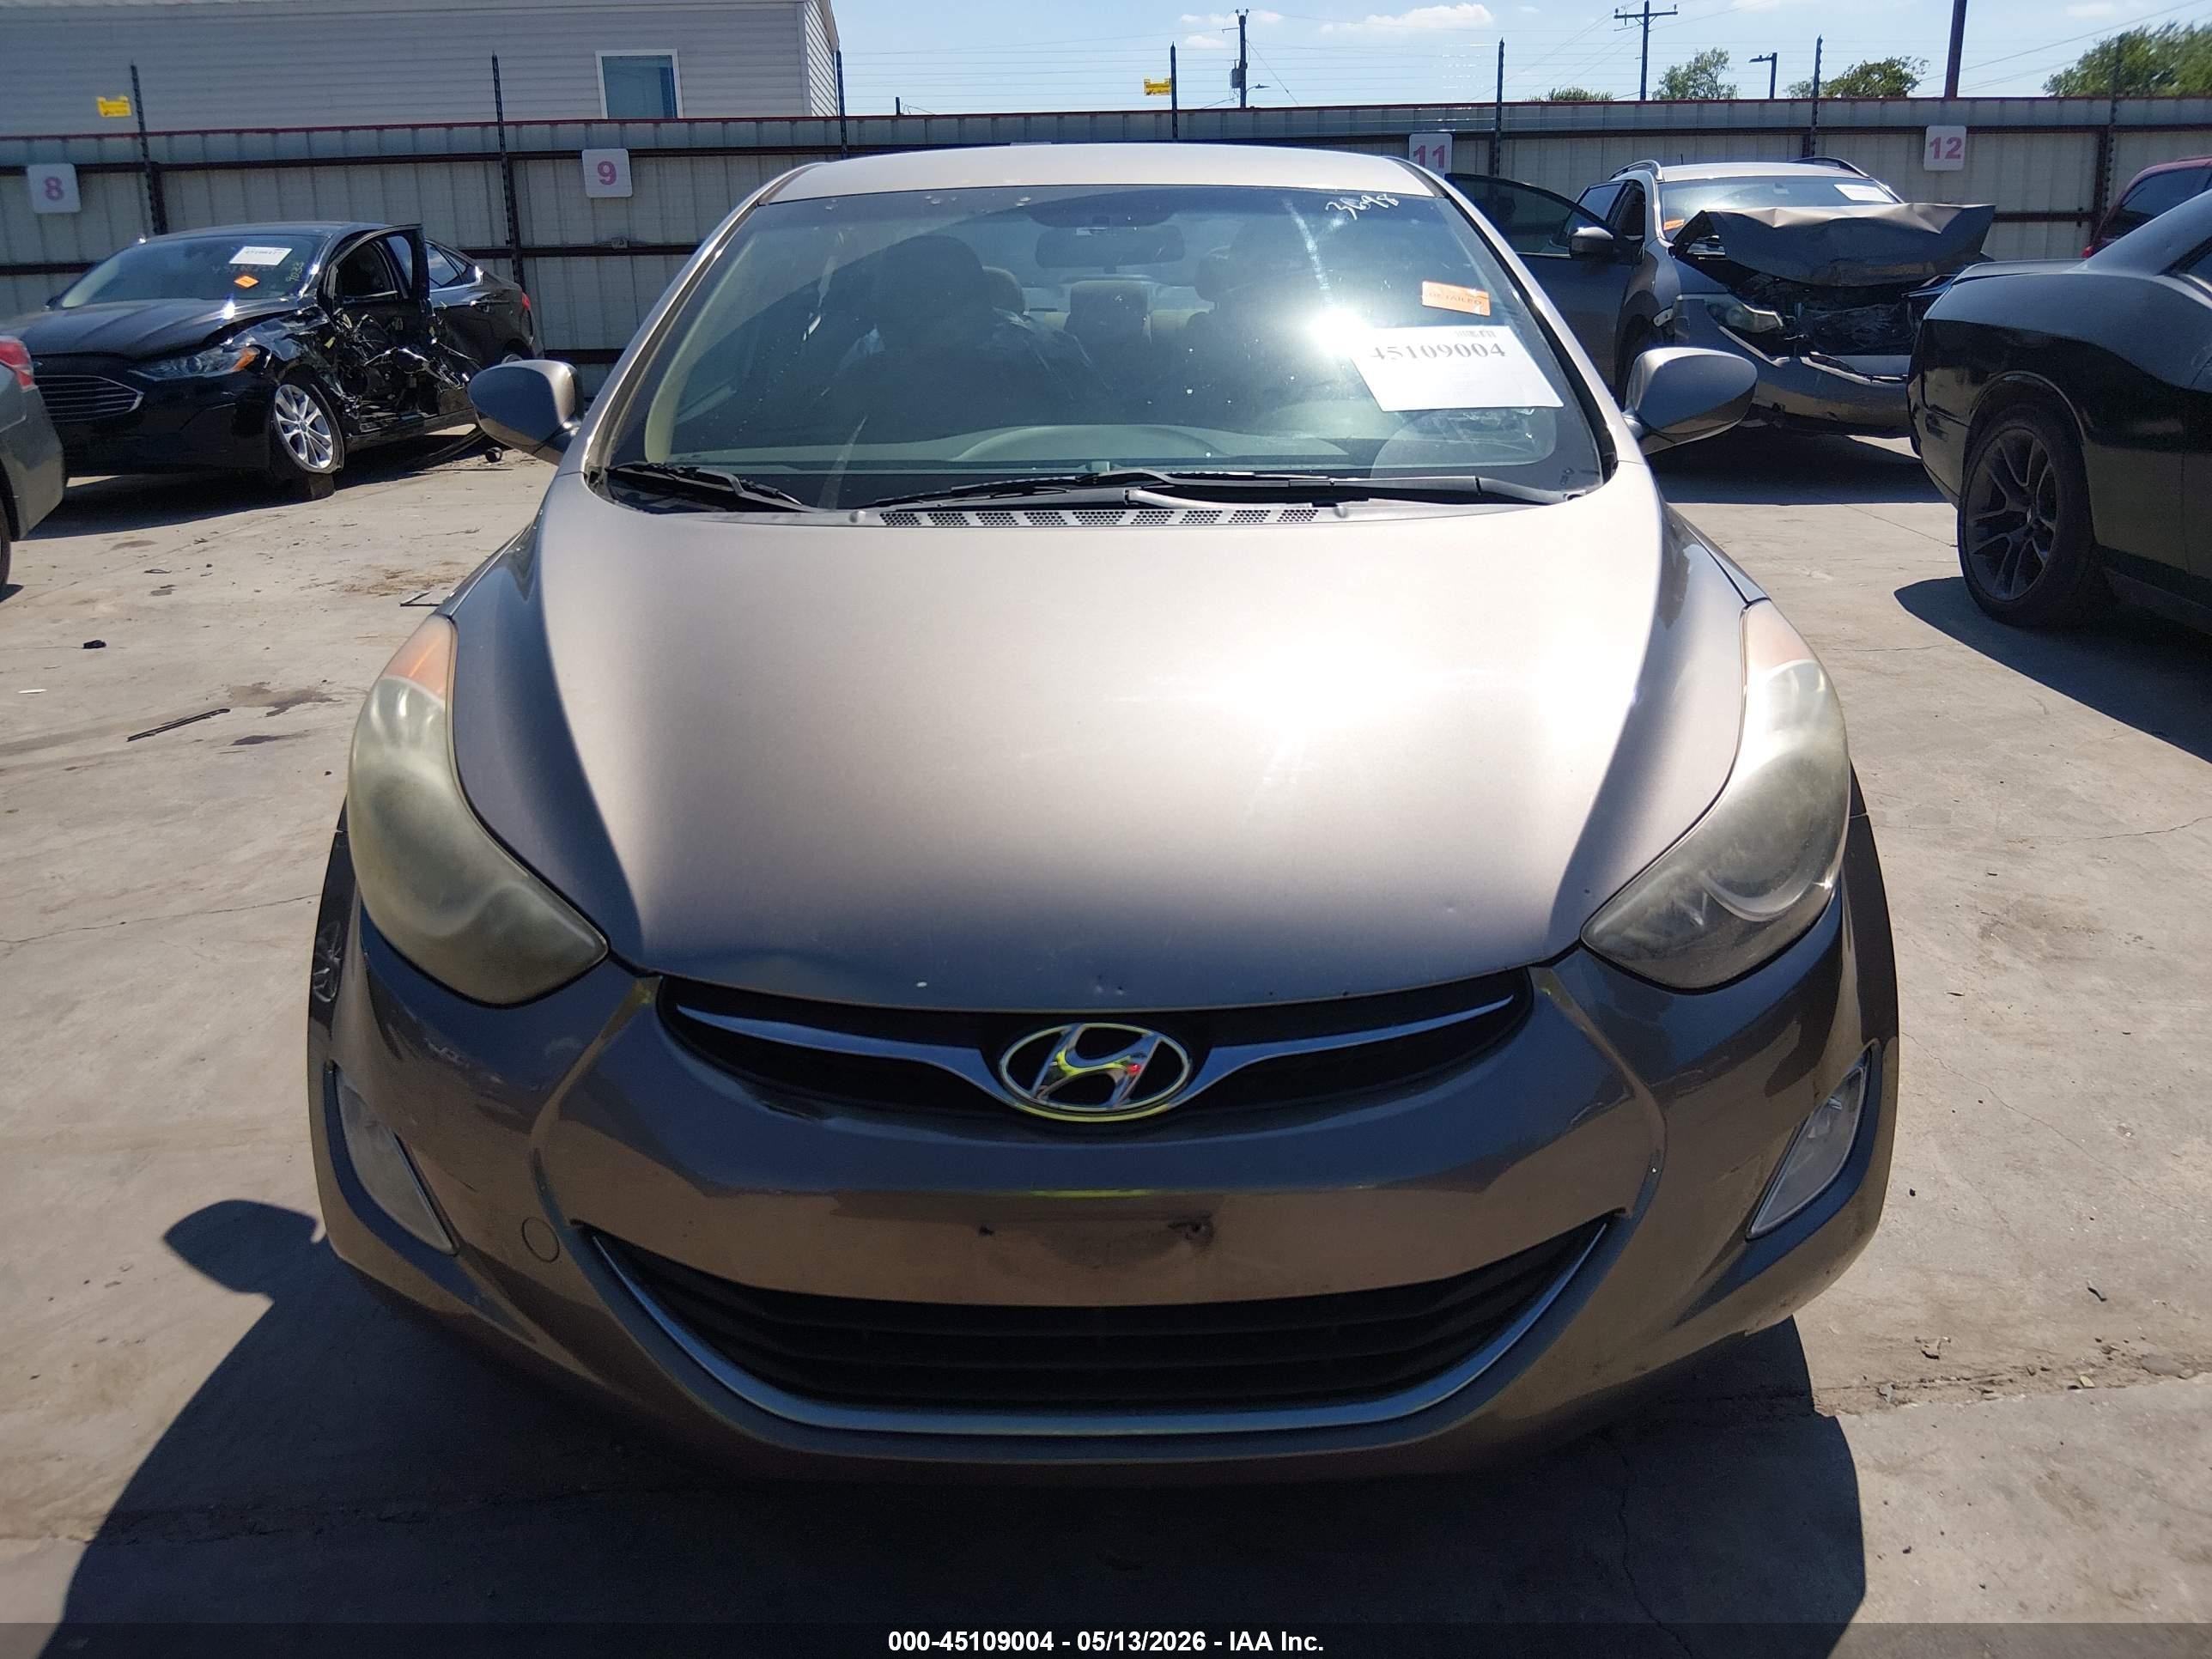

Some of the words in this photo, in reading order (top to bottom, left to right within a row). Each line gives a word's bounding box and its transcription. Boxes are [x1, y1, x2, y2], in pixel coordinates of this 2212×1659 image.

[1413, 144, 1445, 168] 11
[1929, 137, 1962, 160] 12
[597, 160, 617, 185] 9
[44, 176, 65, 201] 8
[1370, 343, 1506, 361] 45109004
